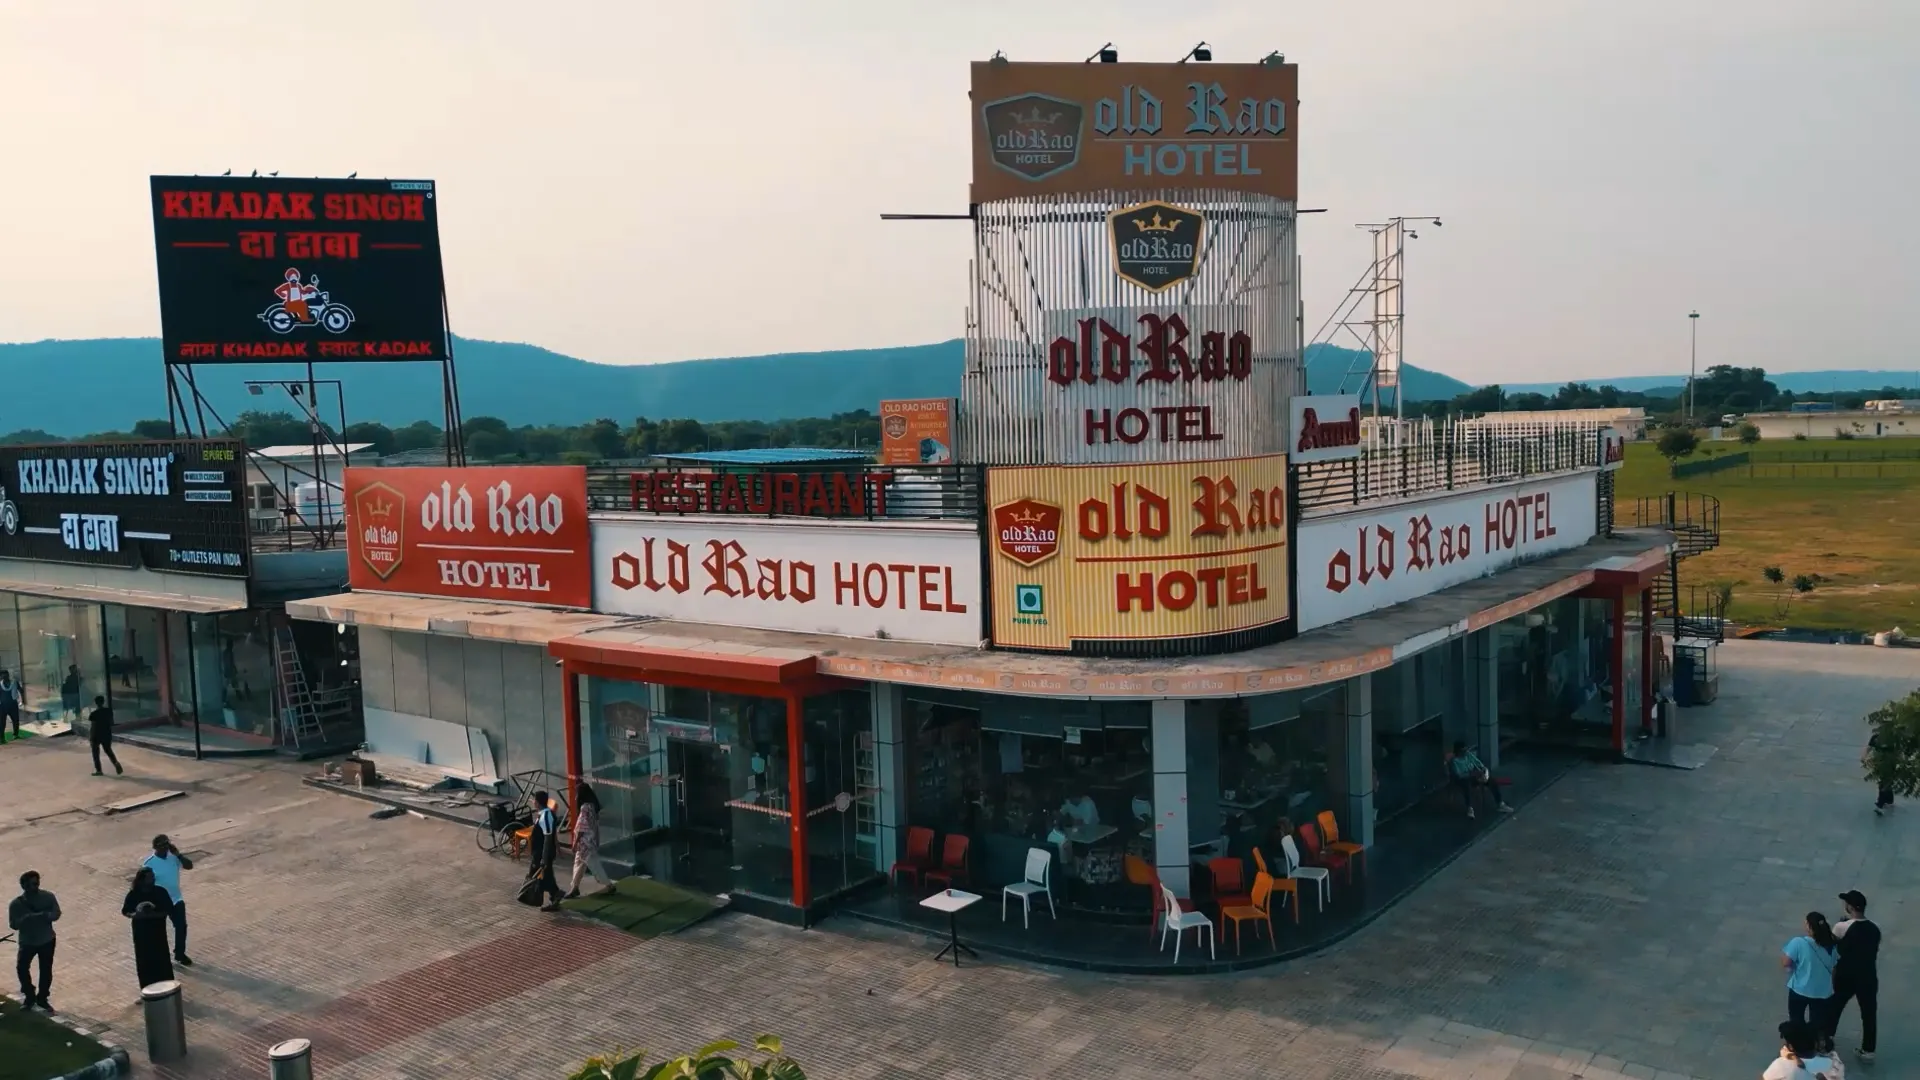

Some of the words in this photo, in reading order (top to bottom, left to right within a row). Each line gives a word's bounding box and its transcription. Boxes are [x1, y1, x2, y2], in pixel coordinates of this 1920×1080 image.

[1094, 83, 1163, 136] old
[1184, 81, 1286, 136] Rao
[1015, 153, 1055, 164] HOTEL
[1123, 143, 1262, 176] HOTEL
[163, 191, 316, 220] KHADAK
[324, 193, 425, 221] SINGH
[238, 231, 277, 259] दा
[285, 231, 361, 259] ढाबा
[1143, 266, 1169, 275] HOTEL
[180, 342, 218, 357] नाम
[223, 341, 308, 357] KHADAK
[364, 340, 433, 356] KADAK
[884, 403, 900, 413] OLD
[902, 403, 919, 412] RAO
[920, 402, 947, 411] HOTEL
[1086, 405, 1224, 446] HOTEL
[18, 458, 100, 494] KHADAK
[103, 457, 169, 496] SINGH
[421, 480, 475, 533] old
[487, 479, 564, 537] Rao
[629, 471, 893, 517] RESTAURANT
[1078, 480, 1170, 542] old
[1190, 474, 1284, 538] Rao
[60, 513, 79, 550] दा
[81, 514, 119, 552] ढाबा
[365, 525, 379, 544] old
[380, 525, 398, 545] Rao
[1014, 545, 1042, 553] HOTEL
[1326, 523, 1395, 594] old
[1406, 512, 1471, 575] Rao
[1484, 492, 1557, 554] HOTEL
[182, 550, 207, 564] OUTLETS
[208, 552, 221, 565] PAN
[223, 553, 241, 566] INDIA
[370, 550, 394, 562] HOTEL
[437, 558, 551, 592] HOTEL
[610, 536, 690, 595] old
[701, 538, 816, 604] Rao
[834, 561, 967, 614] HOTEL
[1116, 562, 1267, 613] HOTEL
[1012, 617, 1031, 625] PURE
[1033, 618, 1048, 626] VEG
